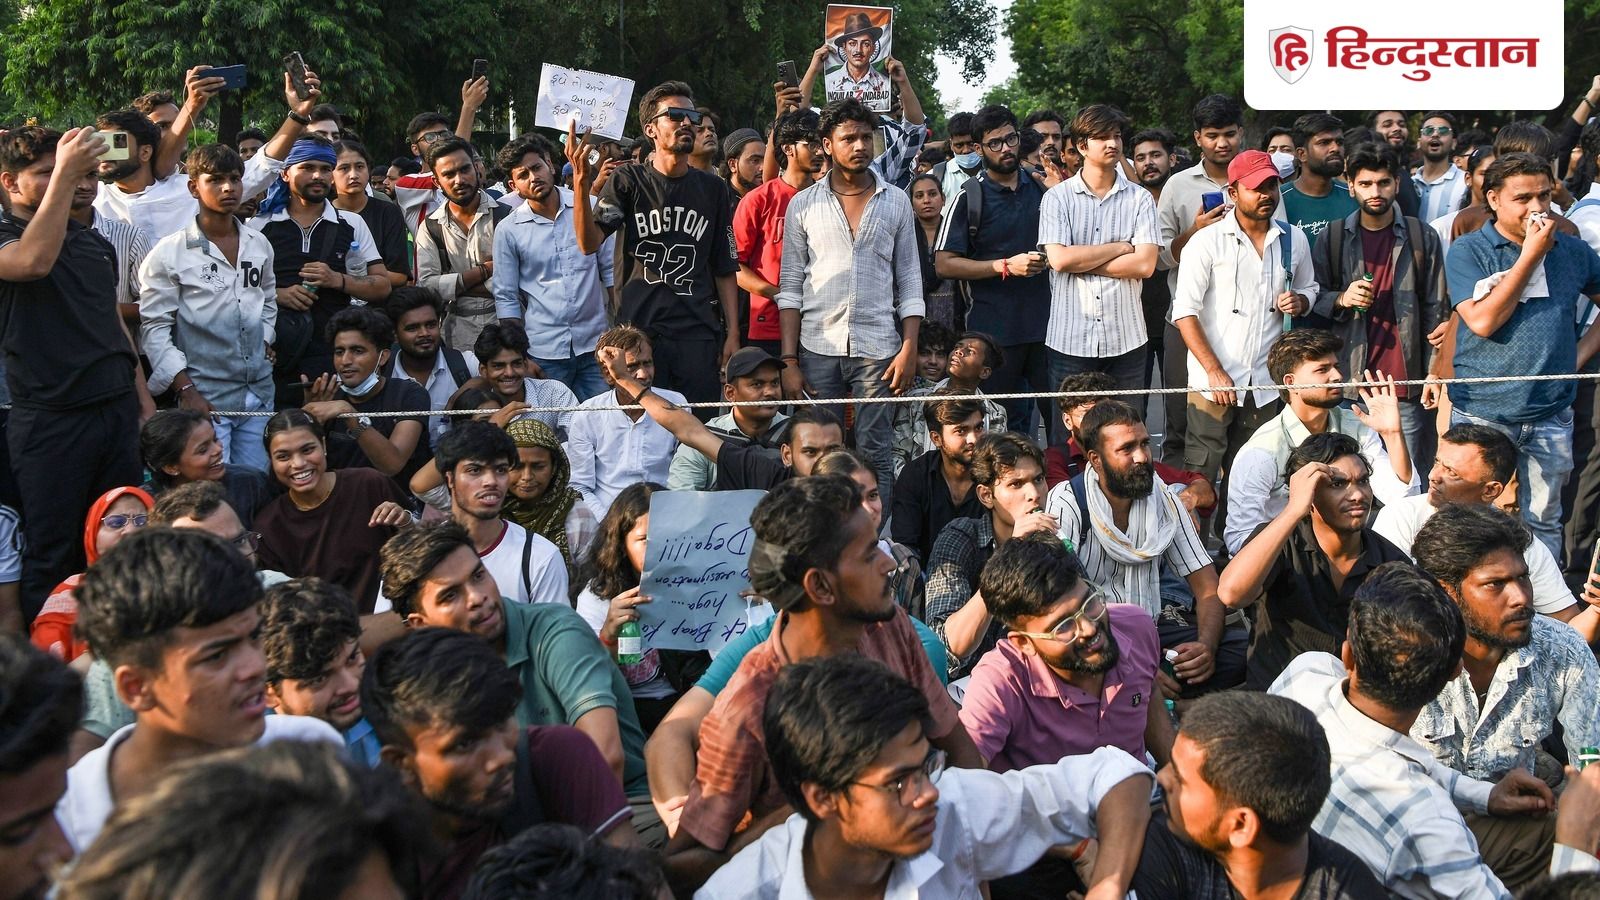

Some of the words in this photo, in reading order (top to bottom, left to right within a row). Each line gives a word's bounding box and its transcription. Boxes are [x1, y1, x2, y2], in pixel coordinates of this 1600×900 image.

[635, 206, 709, 242] BOSTON
[241, 261, 264, 288] To
[635, 240, 697, 296] 32
[671, 619, 718, 643] Baap
